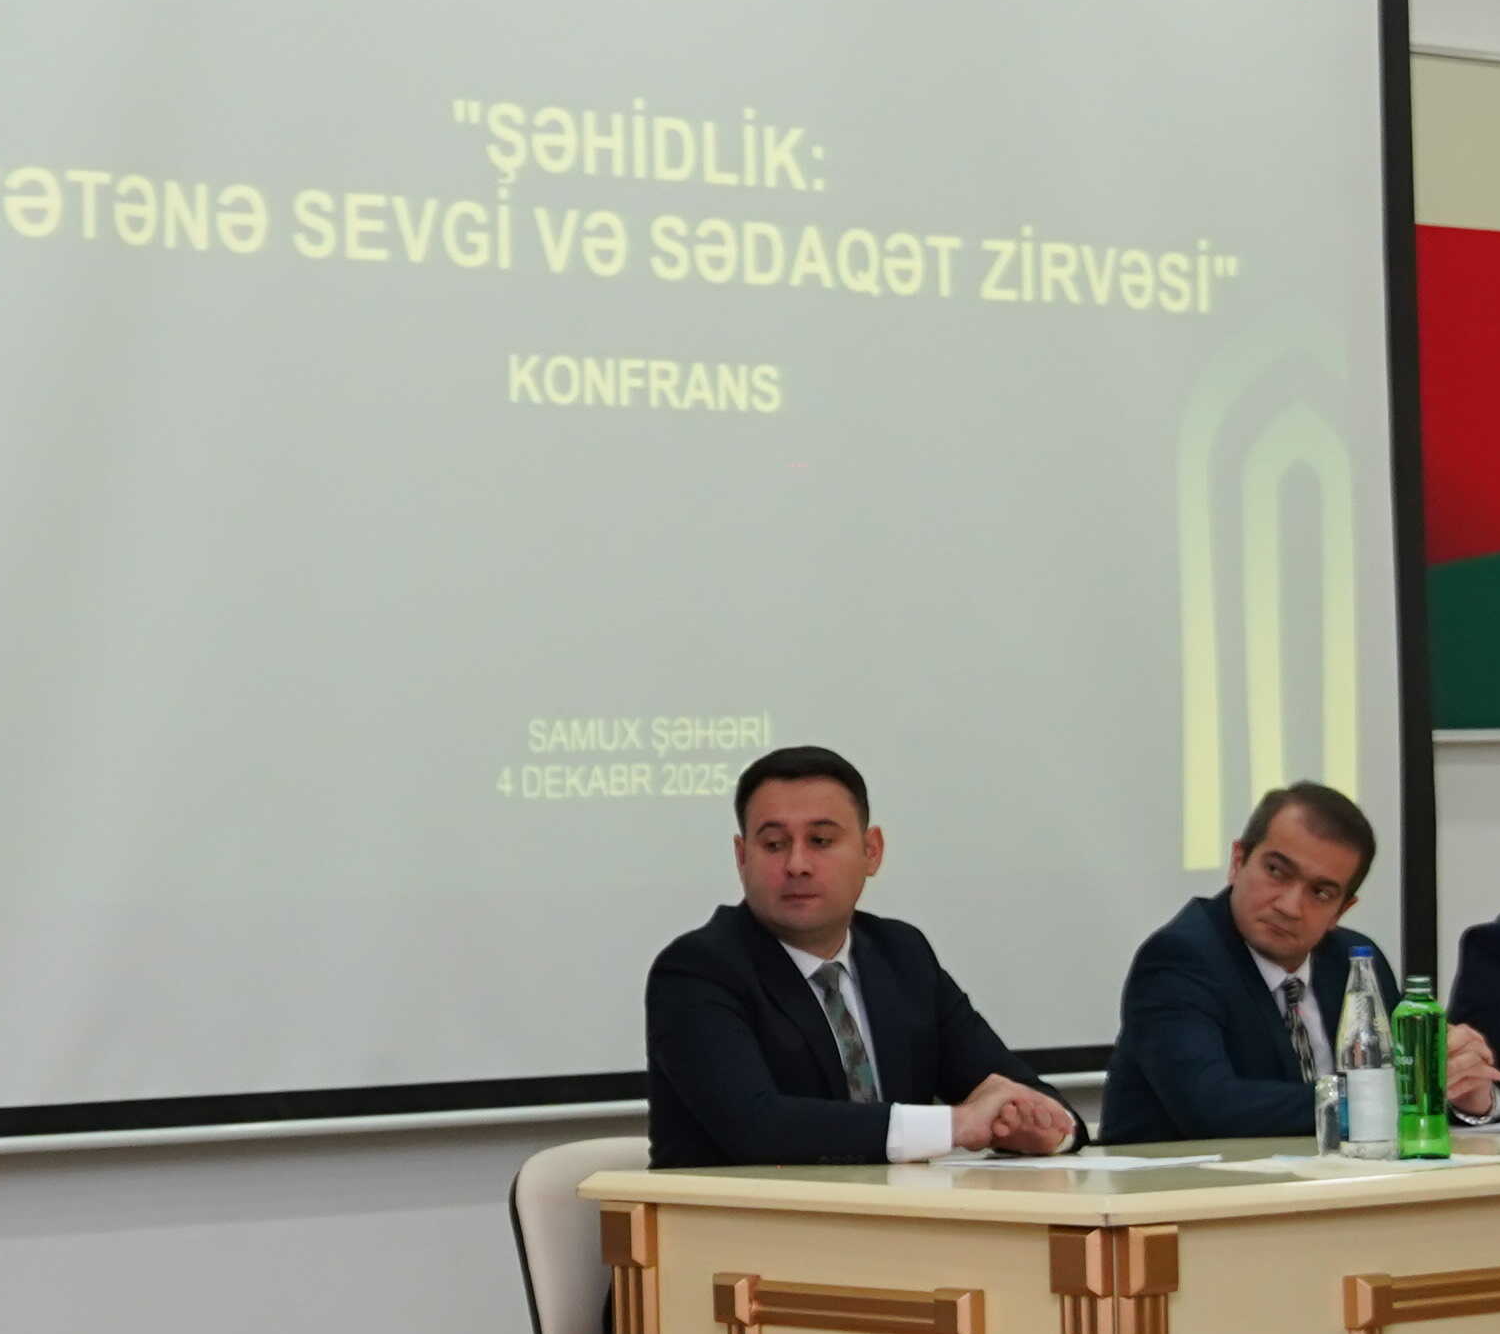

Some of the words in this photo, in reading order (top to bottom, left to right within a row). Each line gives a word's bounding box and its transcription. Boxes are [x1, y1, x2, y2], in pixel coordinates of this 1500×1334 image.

[451, 97, 826, 193] "ŞƏHİDLİK:
[292, 187, 512, 270] SEVGİ
[534, 207, 628, 279] VƏ
[649, 213, 963, 297] SƏDAQƏT
[979, 224, 1240, 315] ZİRVƏSİ"
[508, 354, 782, 413] KONFRANS
[527, 717, 642, 754] SAMUX
[496, 767, 513, 798] 4
[522, 764, 652, 799] DEKABR
